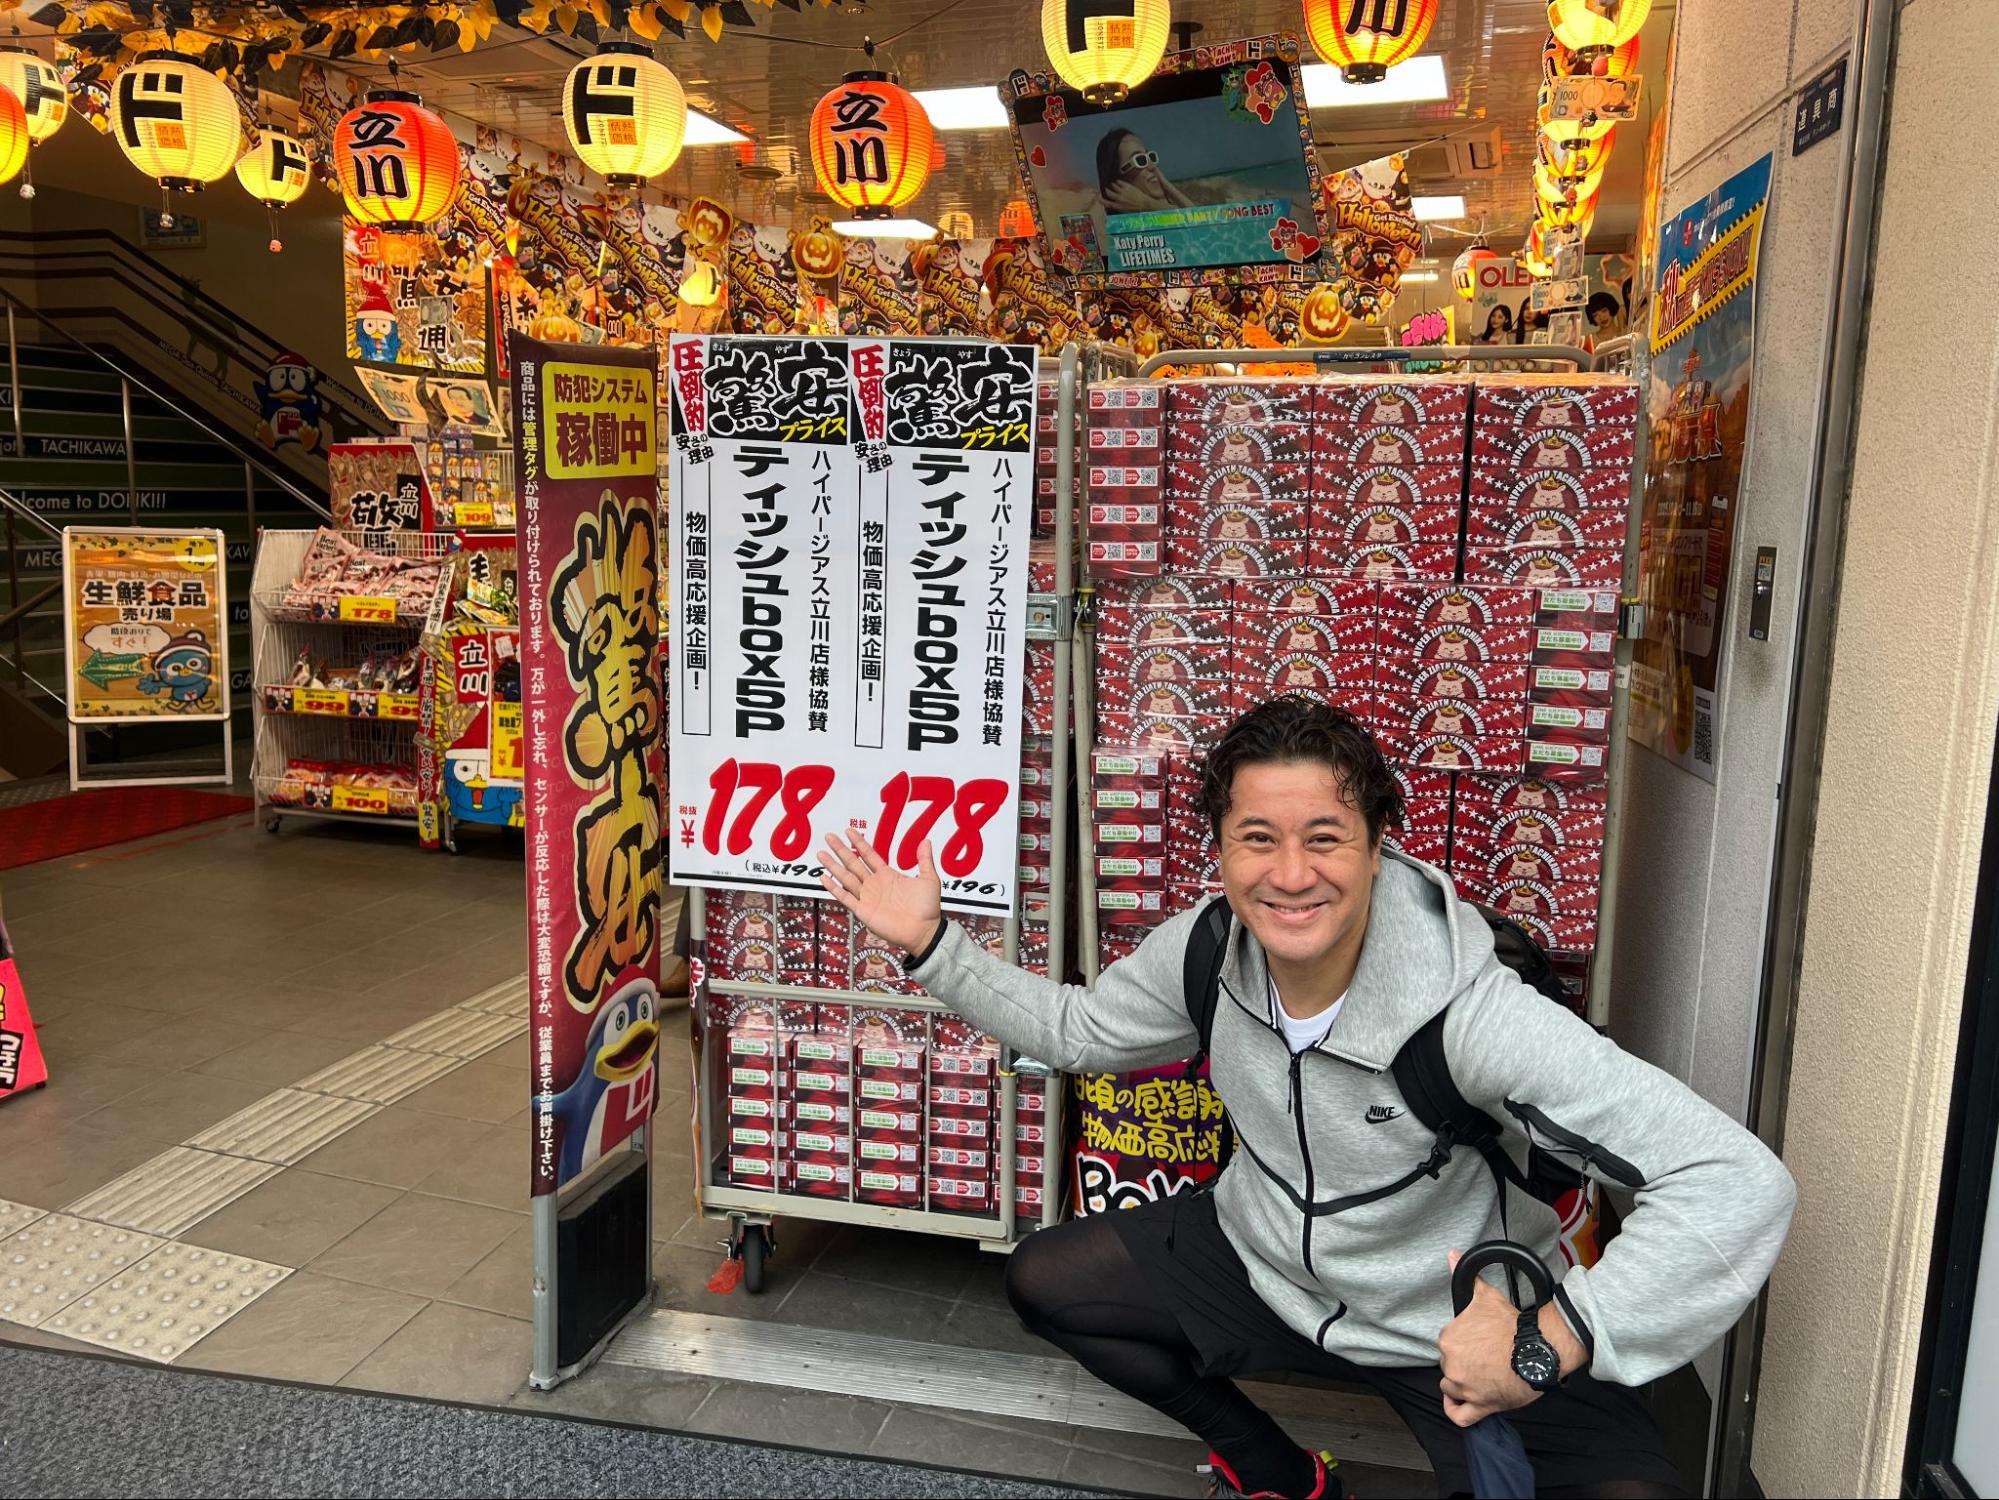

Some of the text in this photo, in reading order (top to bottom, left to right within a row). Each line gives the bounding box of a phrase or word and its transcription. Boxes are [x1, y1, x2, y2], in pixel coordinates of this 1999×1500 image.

[120, 73, 184, 147] ド
[573, 66, 636, 144] ド
[349, 111, 409, 198] 立川
[831, 92, 888, 184] 立川
[271, 140, 306, 181] ド
[1251, 203, 1275, 216] BEST
[1336, 201, 1422, 246] Halloween
[1113, 234, 1165, 250] Katy Perry
[1120, 249, 1175, 268] LIFETIMES
[1479, 265, 1535, 289] OLE
[553, 373, 648, 404] 防犯システム
[672, 340, 705, 432] 圧倒的
[701, 340, 849, 436] 驚安
[850, 344, 885, 440] 圧倒的
[881, 345, 1033, 443] 驚安
[40, 438, 127, 456] TACHIKAWA
[556, 411, 648, 468] 稼働中
[675, 434, 708, 451] 安さの
[780, 416, 847, 442] プライス
[961, 423, 1030, 449] プライス
[1200, 435, 1219, 461] HYPER
[1240, 425, 1272, 461] TACHIKAWA
[1348, 436, 1368, 463] HYPER
[1390, 426, 1424, 463] TACHIKAWA
[688, 445, 715, 465] 理由
[855, 442, 887, 458] 安さの
[867, 453, 893, 473] 理由
[1510, 439, 1531, 466] HYPER
[1555, 429, 1591, 466] TACHIKAWA
[3, 491, 71, 509] lcome
[77, 494, 92, 509] to
[399, 482, 420, 520] 立川
[463, 512, 492, 523] 109
[1505, 520, 1526, 548] HYPER
[1548, 510, 1584, 548] TACHIKAWA
[84, 580, 207, 607] 生鮮食品
[685, 511, 707, 690] 物価高応援企画!
[733, 445, 790, 738] ティッシュbox5P
[807, 450, 832, 732] ハイパージアス立川店様協賛
[907, 453, 970, 752] ティッシュbox5P
[981, 457, 1013, 747] ハイパージアス立川店様協賛
[1414, 596, 1435, 623] HYPER
[1457, 586, 1493, 623] TACHIKAWA
[121, 607, 172, 621] 売り場
[351, 607, 393, 619] 178
[860, 521, 884, 702] 物価高応援企画!
[1267, 625, 1286, 650] HYPER
[1306, 616, 1337, 650] TACHIKAWA
[459, 638, 489, 695] 立川
[304, 700, 345, 712] 99
[343, 797, 386, 810] 100
[679, 806, 697, 816] 税抜
[703, 757, 835, 862] 178
[872, 770, 1009, 878] 178
[1492, 819, 1511, 840] HYPER
[1532, 809, 1564, 845] TACHIKAWA
[1489, 854, 1508, 875] HYPER
[1529, 844, 1561, 880] TACHIKAWA
[1369, 1105, 1395, 1118] NIKE
